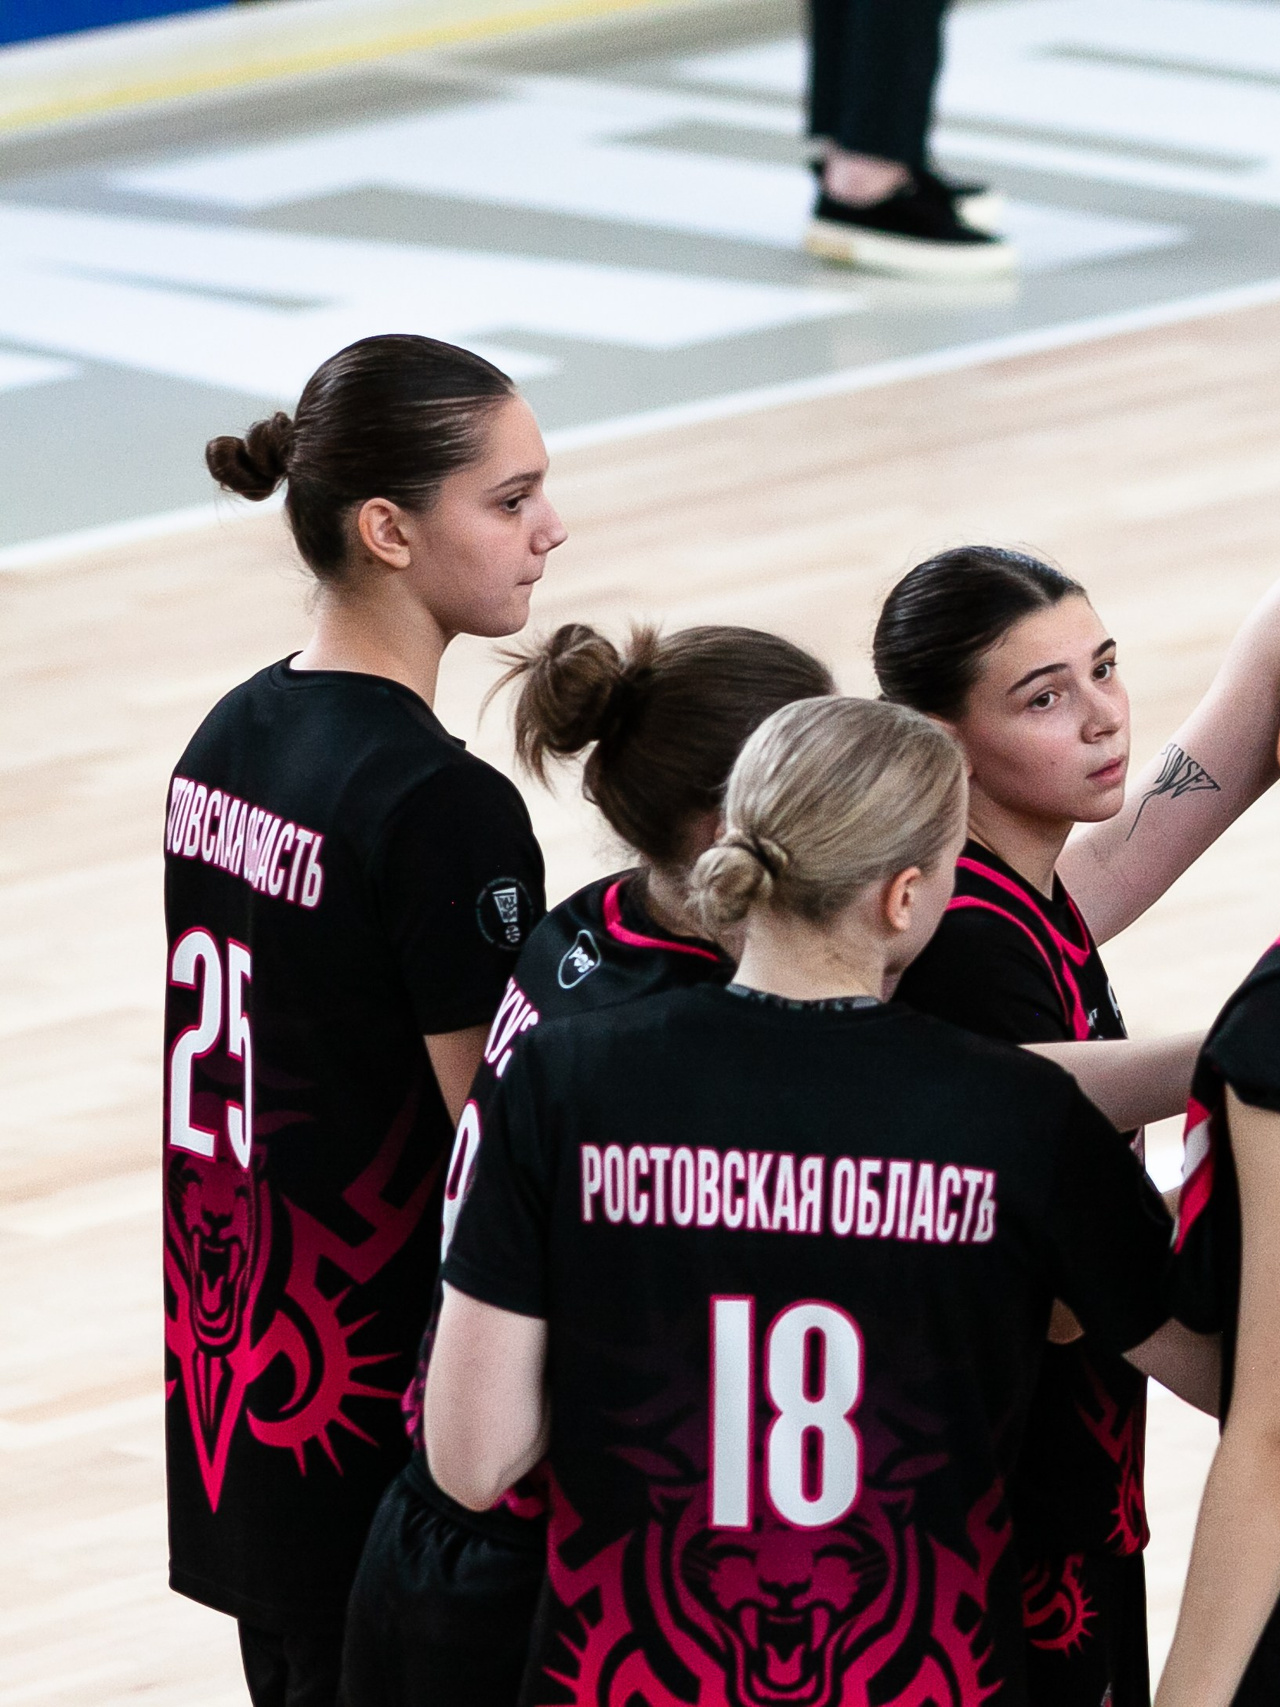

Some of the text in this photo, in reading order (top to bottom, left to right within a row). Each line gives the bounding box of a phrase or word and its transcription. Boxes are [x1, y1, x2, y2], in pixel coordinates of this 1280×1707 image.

[168, 926, 254, 1172] 25
[579, 1142, 998, 1244] РОСТОВСКАЯ ОБЛАСТЬ
[708, 1294, 865, 1532] 18
